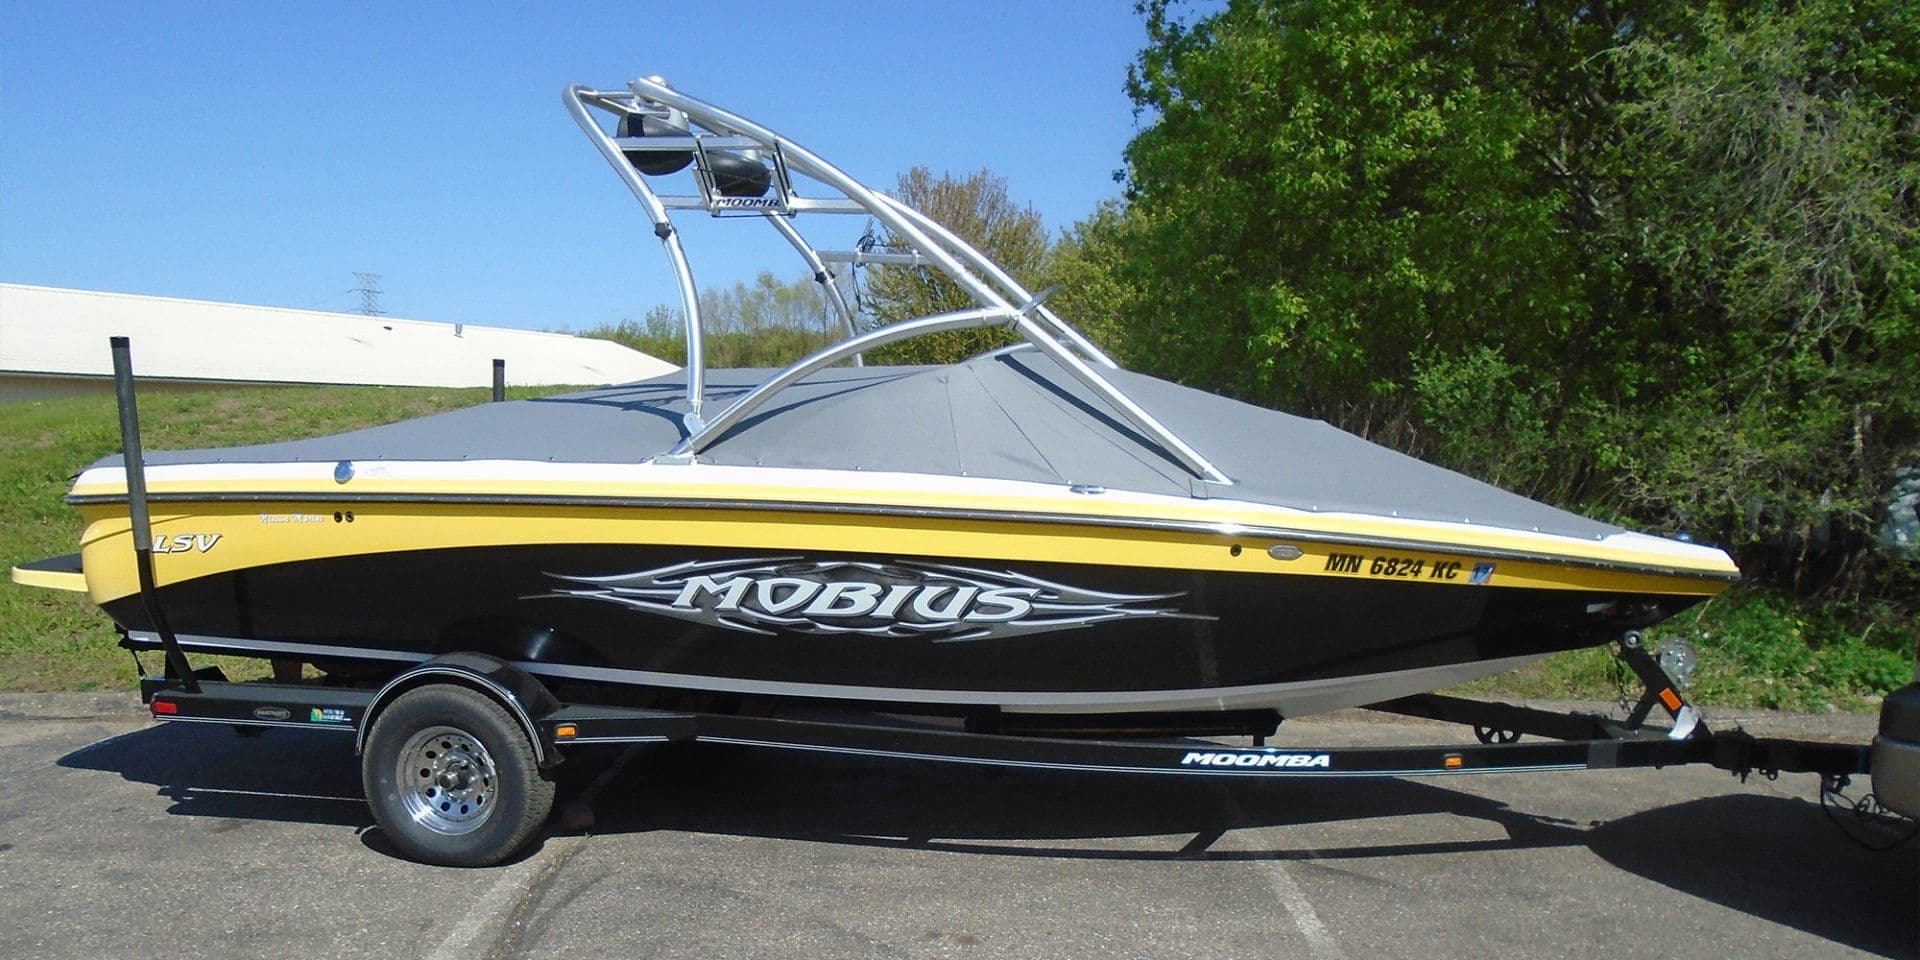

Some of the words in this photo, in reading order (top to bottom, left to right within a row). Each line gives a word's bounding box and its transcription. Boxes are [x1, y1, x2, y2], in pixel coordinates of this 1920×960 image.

[717, 198, 781, 207] MOOMB
[152, 533, 222, 554] LSV
[1325, 553, 1363, 573] MN
[1370, 556, 1424, 577] 6824
[1430, 560, 1462, 579] KC
[671, 575, 1040, 622] MOBIUS
[1181, 752, 1330, 767] MOOMBA
